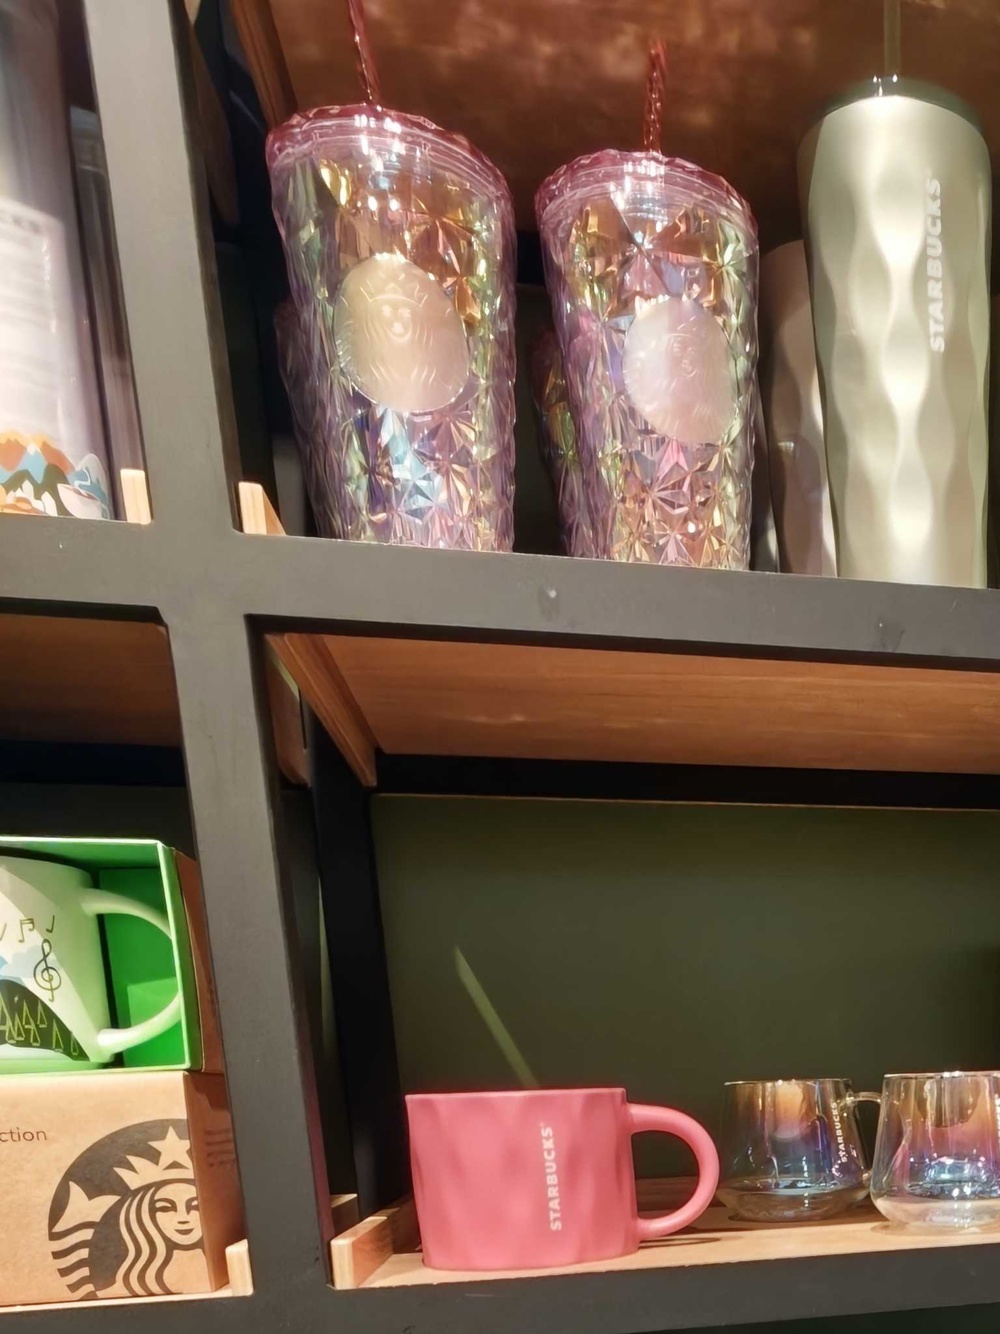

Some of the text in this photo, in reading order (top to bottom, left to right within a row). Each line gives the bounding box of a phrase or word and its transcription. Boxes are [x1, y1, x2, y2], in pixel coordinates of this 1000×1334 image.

[926, 178, 946, 354] STARBUCKS
[541, 1126, 562, 1232] STARBUCKS
[832, 1102, 848, 1163] STARBUCKS
